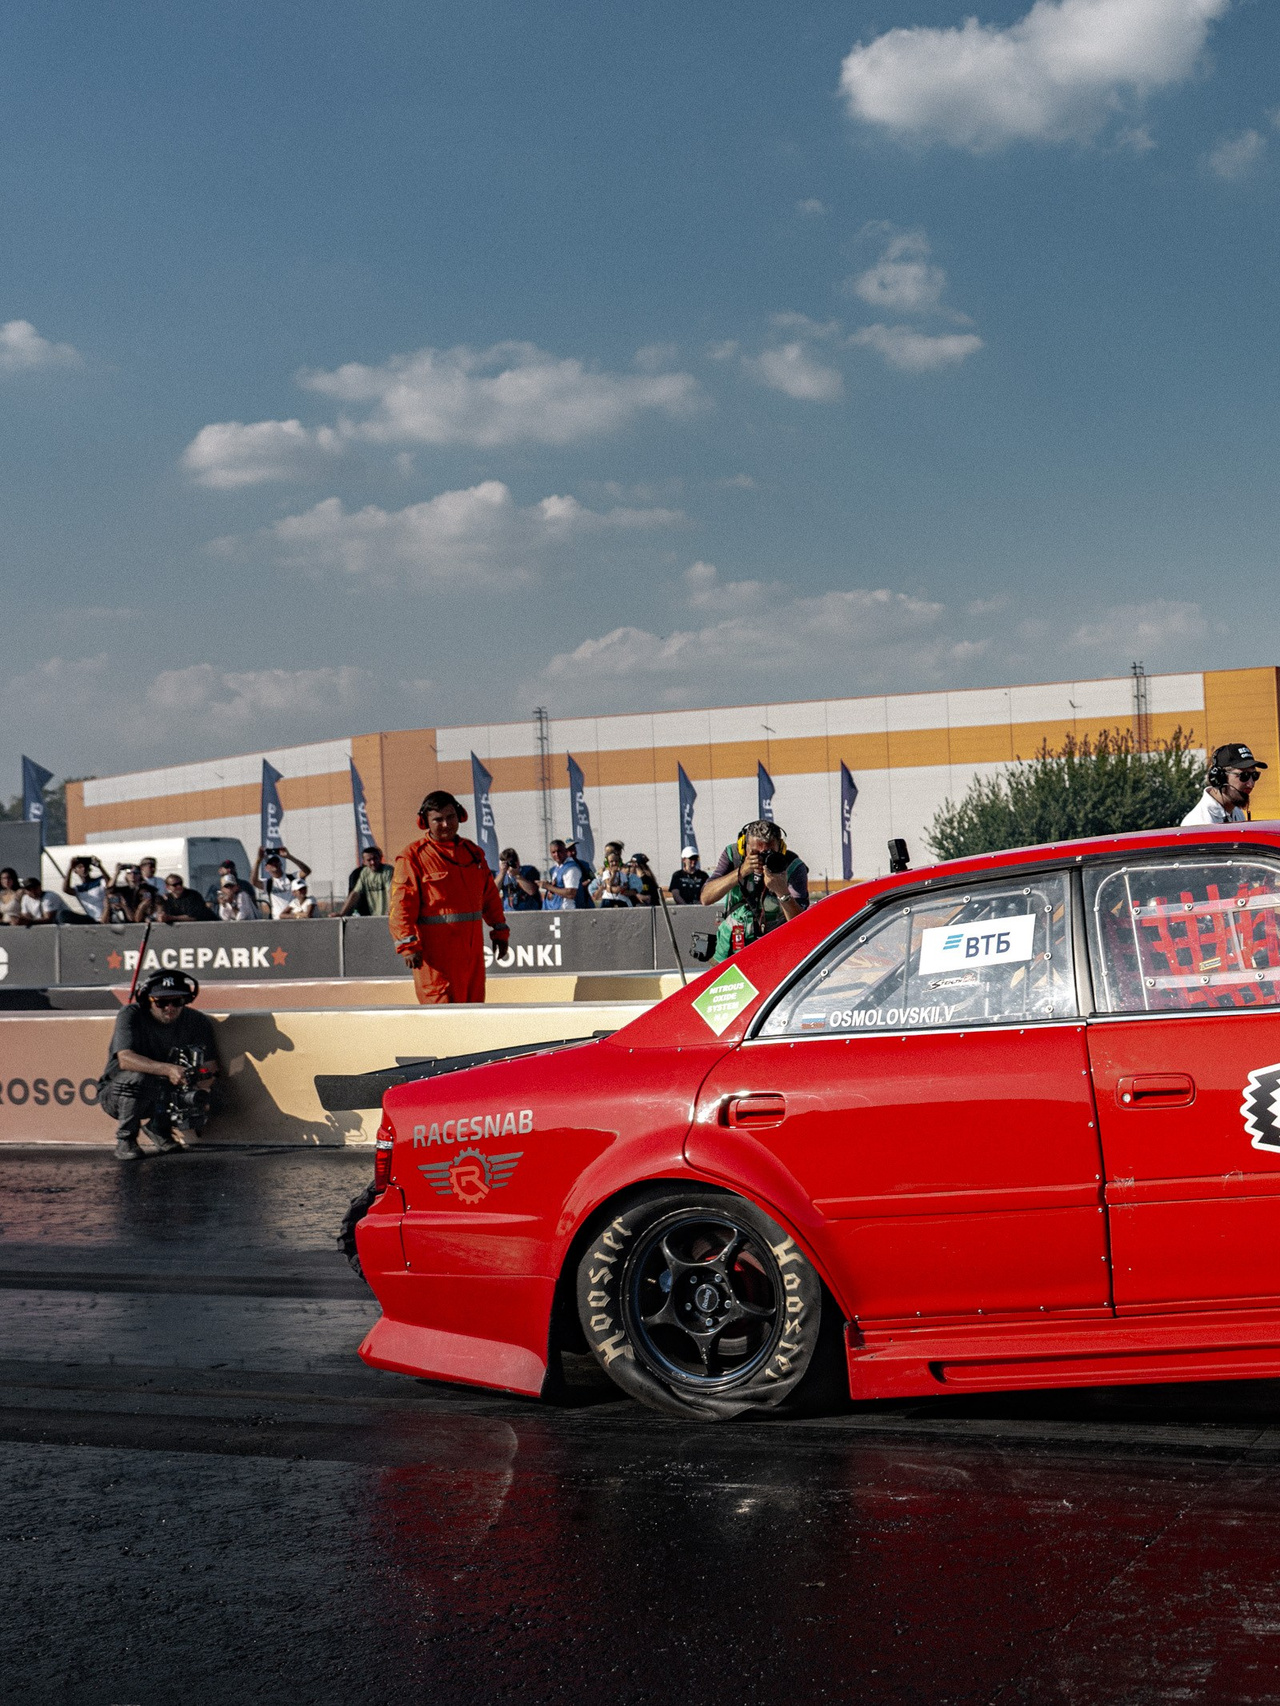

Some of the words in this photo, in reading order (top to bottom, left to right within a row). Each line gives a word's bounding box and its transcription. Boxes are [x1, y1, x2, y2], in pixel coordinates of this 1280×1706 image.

[965, 931, 1011, 958] ВТБ
[123, 946, 270, 971] RACEPARK
[709, 982, 745, 994] NITROUS
[713, 992, 737, 1003] OXIDE
[706, 1001, 739, 1013] SYSTEM
[413, 1109, 533, 1149] RACESNAB
[587, 1215, 636, 1368] Hoosier
